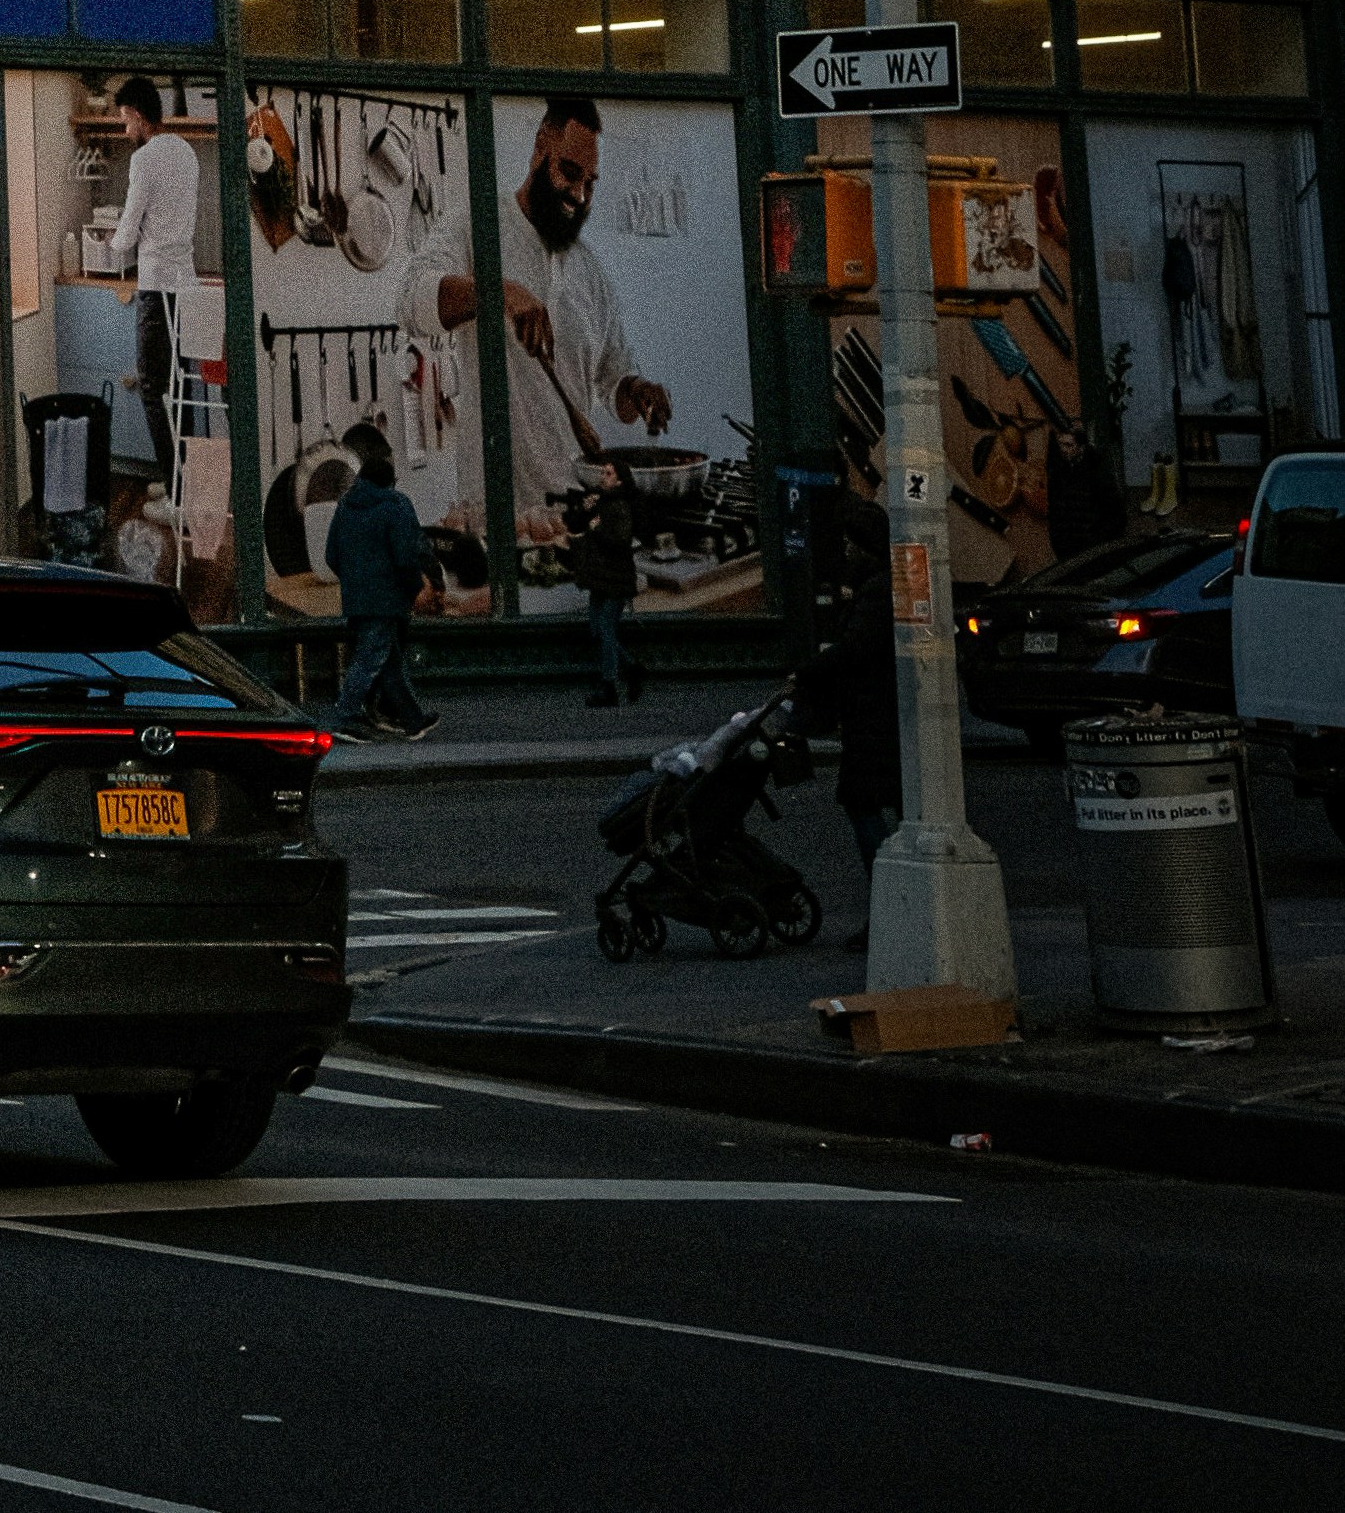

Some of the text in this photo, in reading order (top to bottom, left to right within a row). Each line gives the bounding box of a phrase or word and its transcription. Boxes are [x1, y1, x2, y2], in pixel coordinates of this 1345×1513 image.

[814, 50, 938, 89] ONE WAY
[102, 793, 181, 825] T757858C
[1096, 807, 1127, 821] litter
[1129, 807, 1144, 820] in
[1146, 807, 1166, 821] its
[1170, 805, 1213, 824] place.
